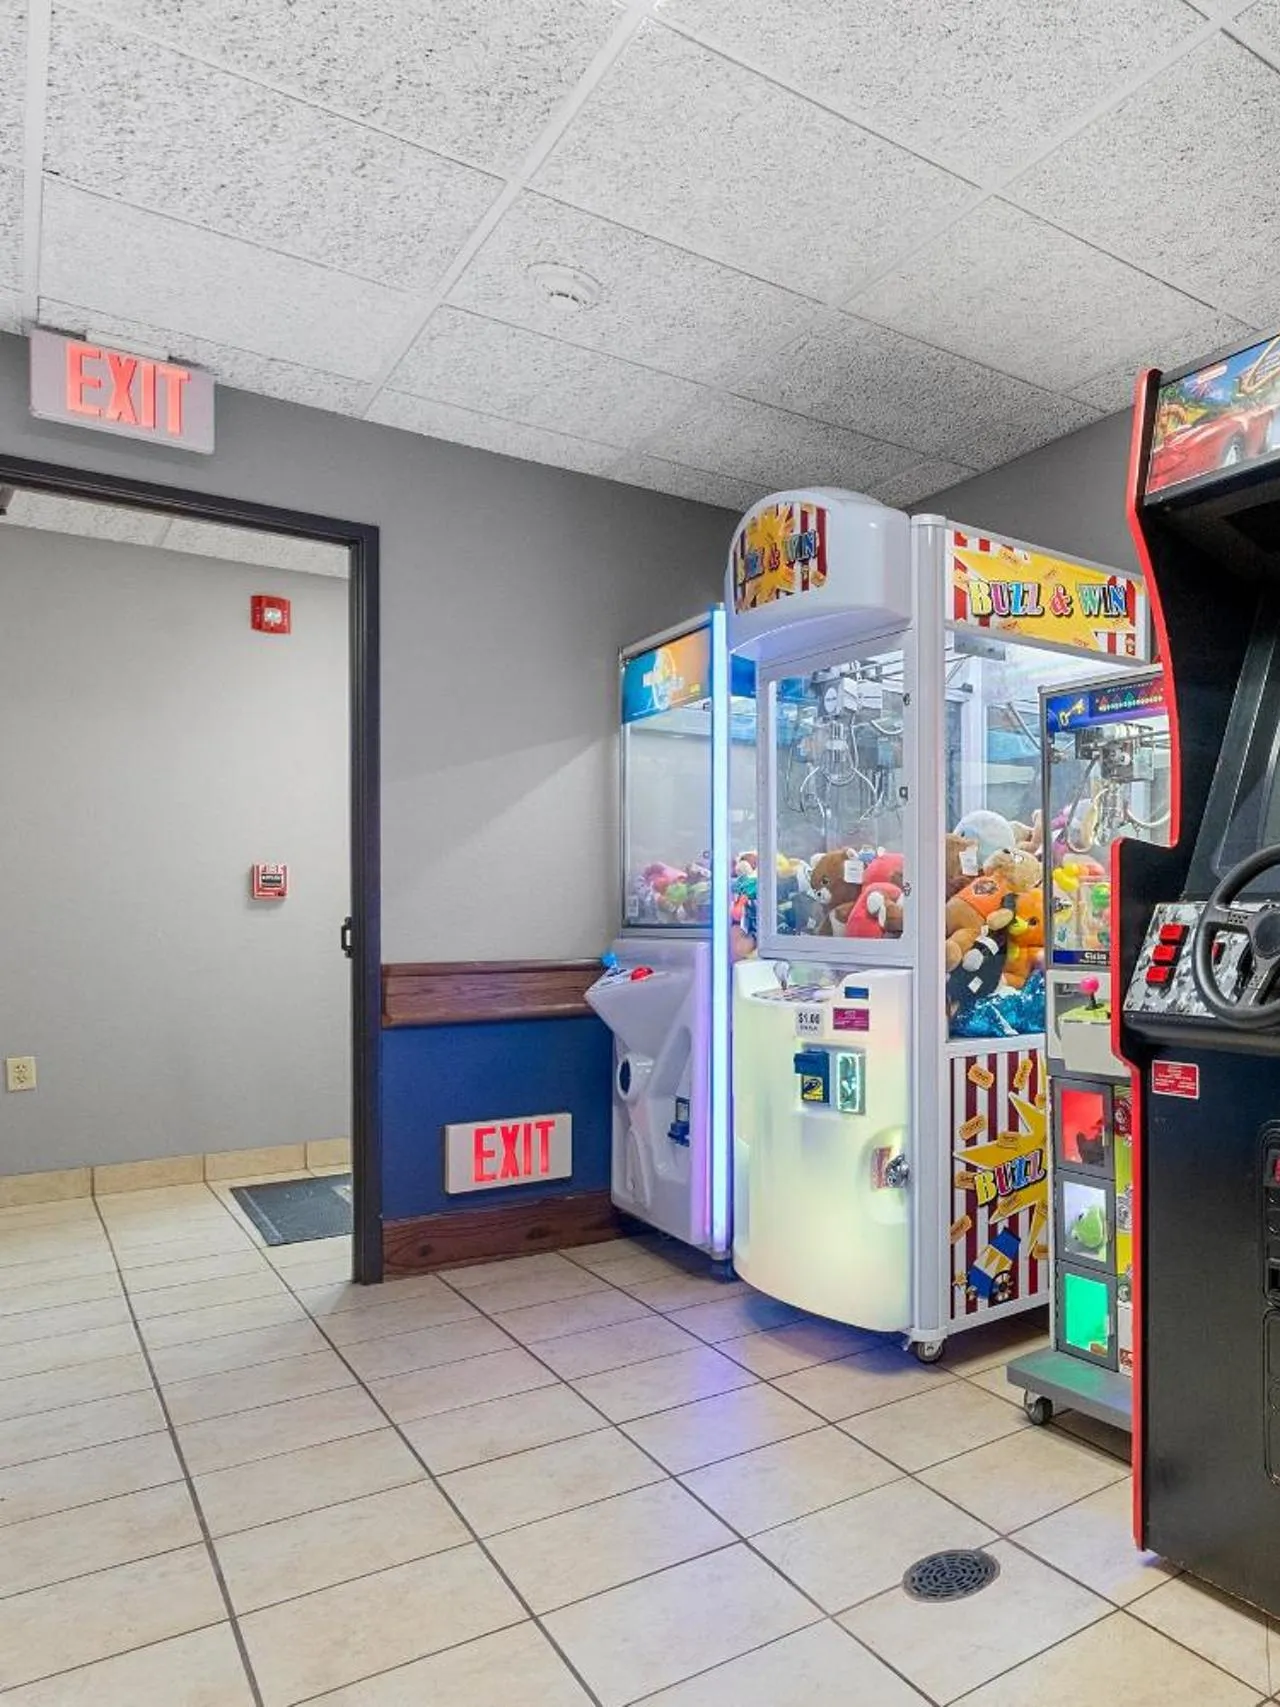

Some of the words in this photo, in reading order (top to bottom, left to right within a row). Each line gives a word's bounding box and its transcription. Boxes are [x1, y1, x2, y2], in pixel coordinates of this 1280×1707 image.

[67, 342, 191, 435] EXIT
[969, 581, 1043, 617] BUZZ
[1051, 584, 1073, 617] &
[1077, 583, 1128, 617] WIN
[473, 1119, 556, 1182] EXIT
[974, 1149, 1047, 1207] BUZZ
